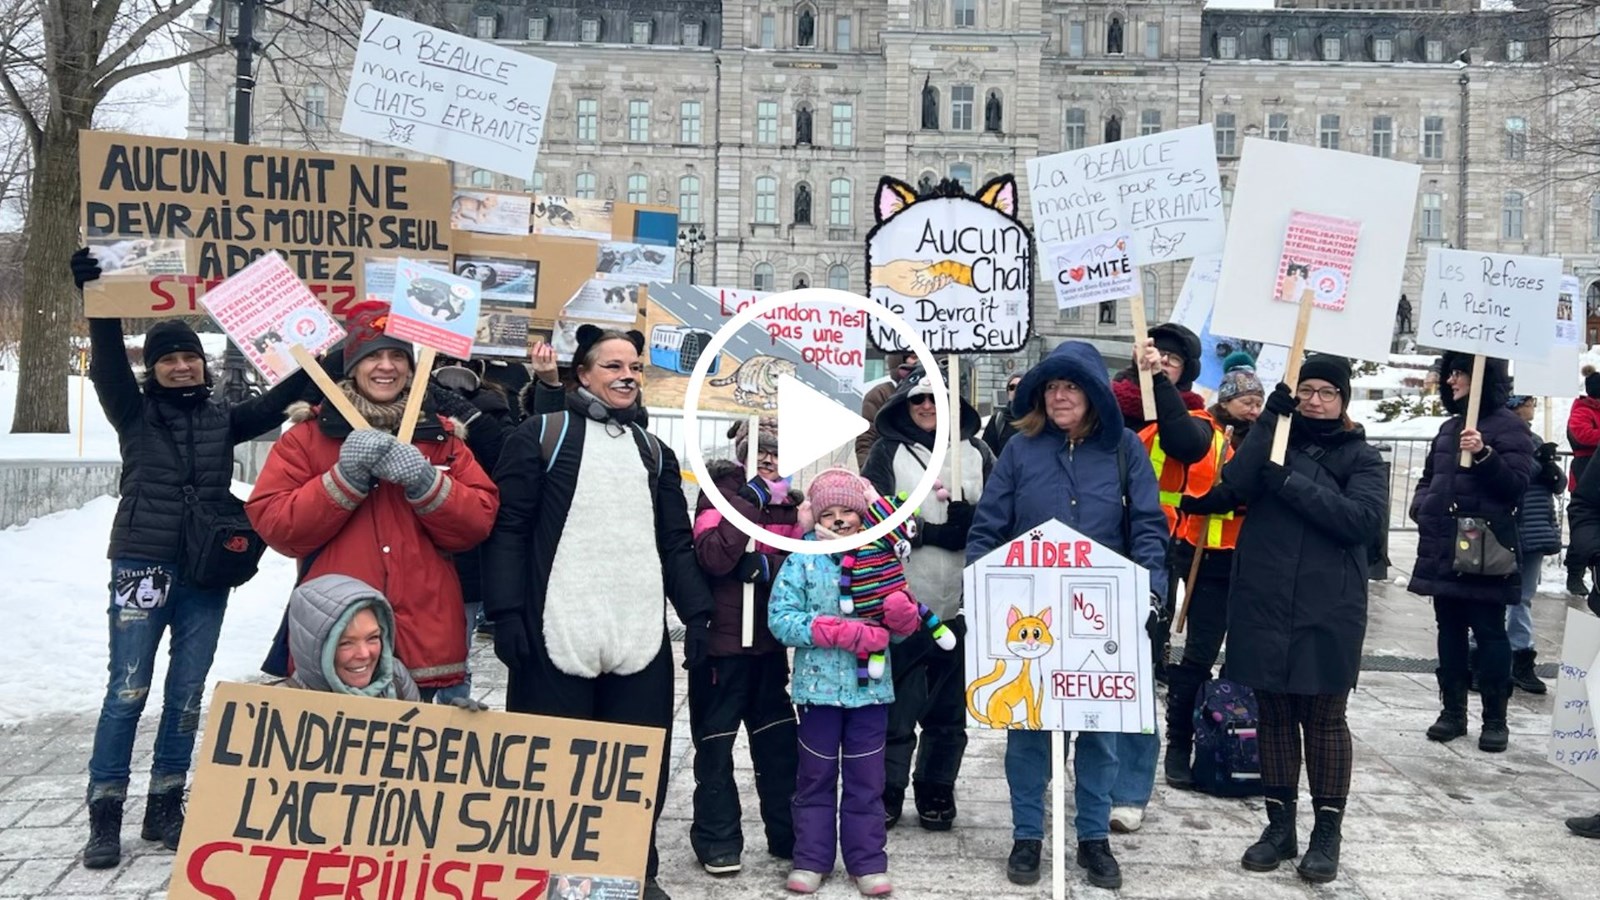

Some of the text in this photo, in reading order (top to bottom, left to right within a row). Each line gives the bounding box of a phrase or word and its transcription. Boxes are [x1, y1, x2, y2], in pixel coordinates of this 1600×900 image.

[363, 18, 518, 81] La BEAUCE
[353, 82, 540, 146] CHATS ERRANTS
[362, 61, 445, 92] marche
[503, 96, 542, 121] ses
[99, 144, 408, 211] AUCUN CHAT NE
[1033, 140, 1180, 191] La BEAUCE
[1038, 186, 1106, 216] marche
[1167, 168, 1207, 186] ses
[1039, 185, 1222, 244] CHATS ERRANTS
[86, 199, 449, 251] DEVRAIS MOURIR SEUL
[915, 218, 1021, 255] Aucun
[198, 241, 356, 281] ADTEZ
[970, 247, 1031, 294] Chat
[1438, 253, 1465, 282] Les
[1480, 256, 1545, 291] Refuges
[915, 296, 1000, 323] Devrait
[766, 322, 843, 346] pas une
[802, 344, 863, 370] option
[879, 321, 1023, 349] Morir Seul
[1005, 539, 1093, 568] AIDER
[1072, 592, 1105, 630] NOS
[1052, 672, 1136, 700] REFUGES
[212, 700, 653, 811] L'INDIFFÉRENCE TUE,
[233, 777, 603, 862] L'ACTION SAUVE
